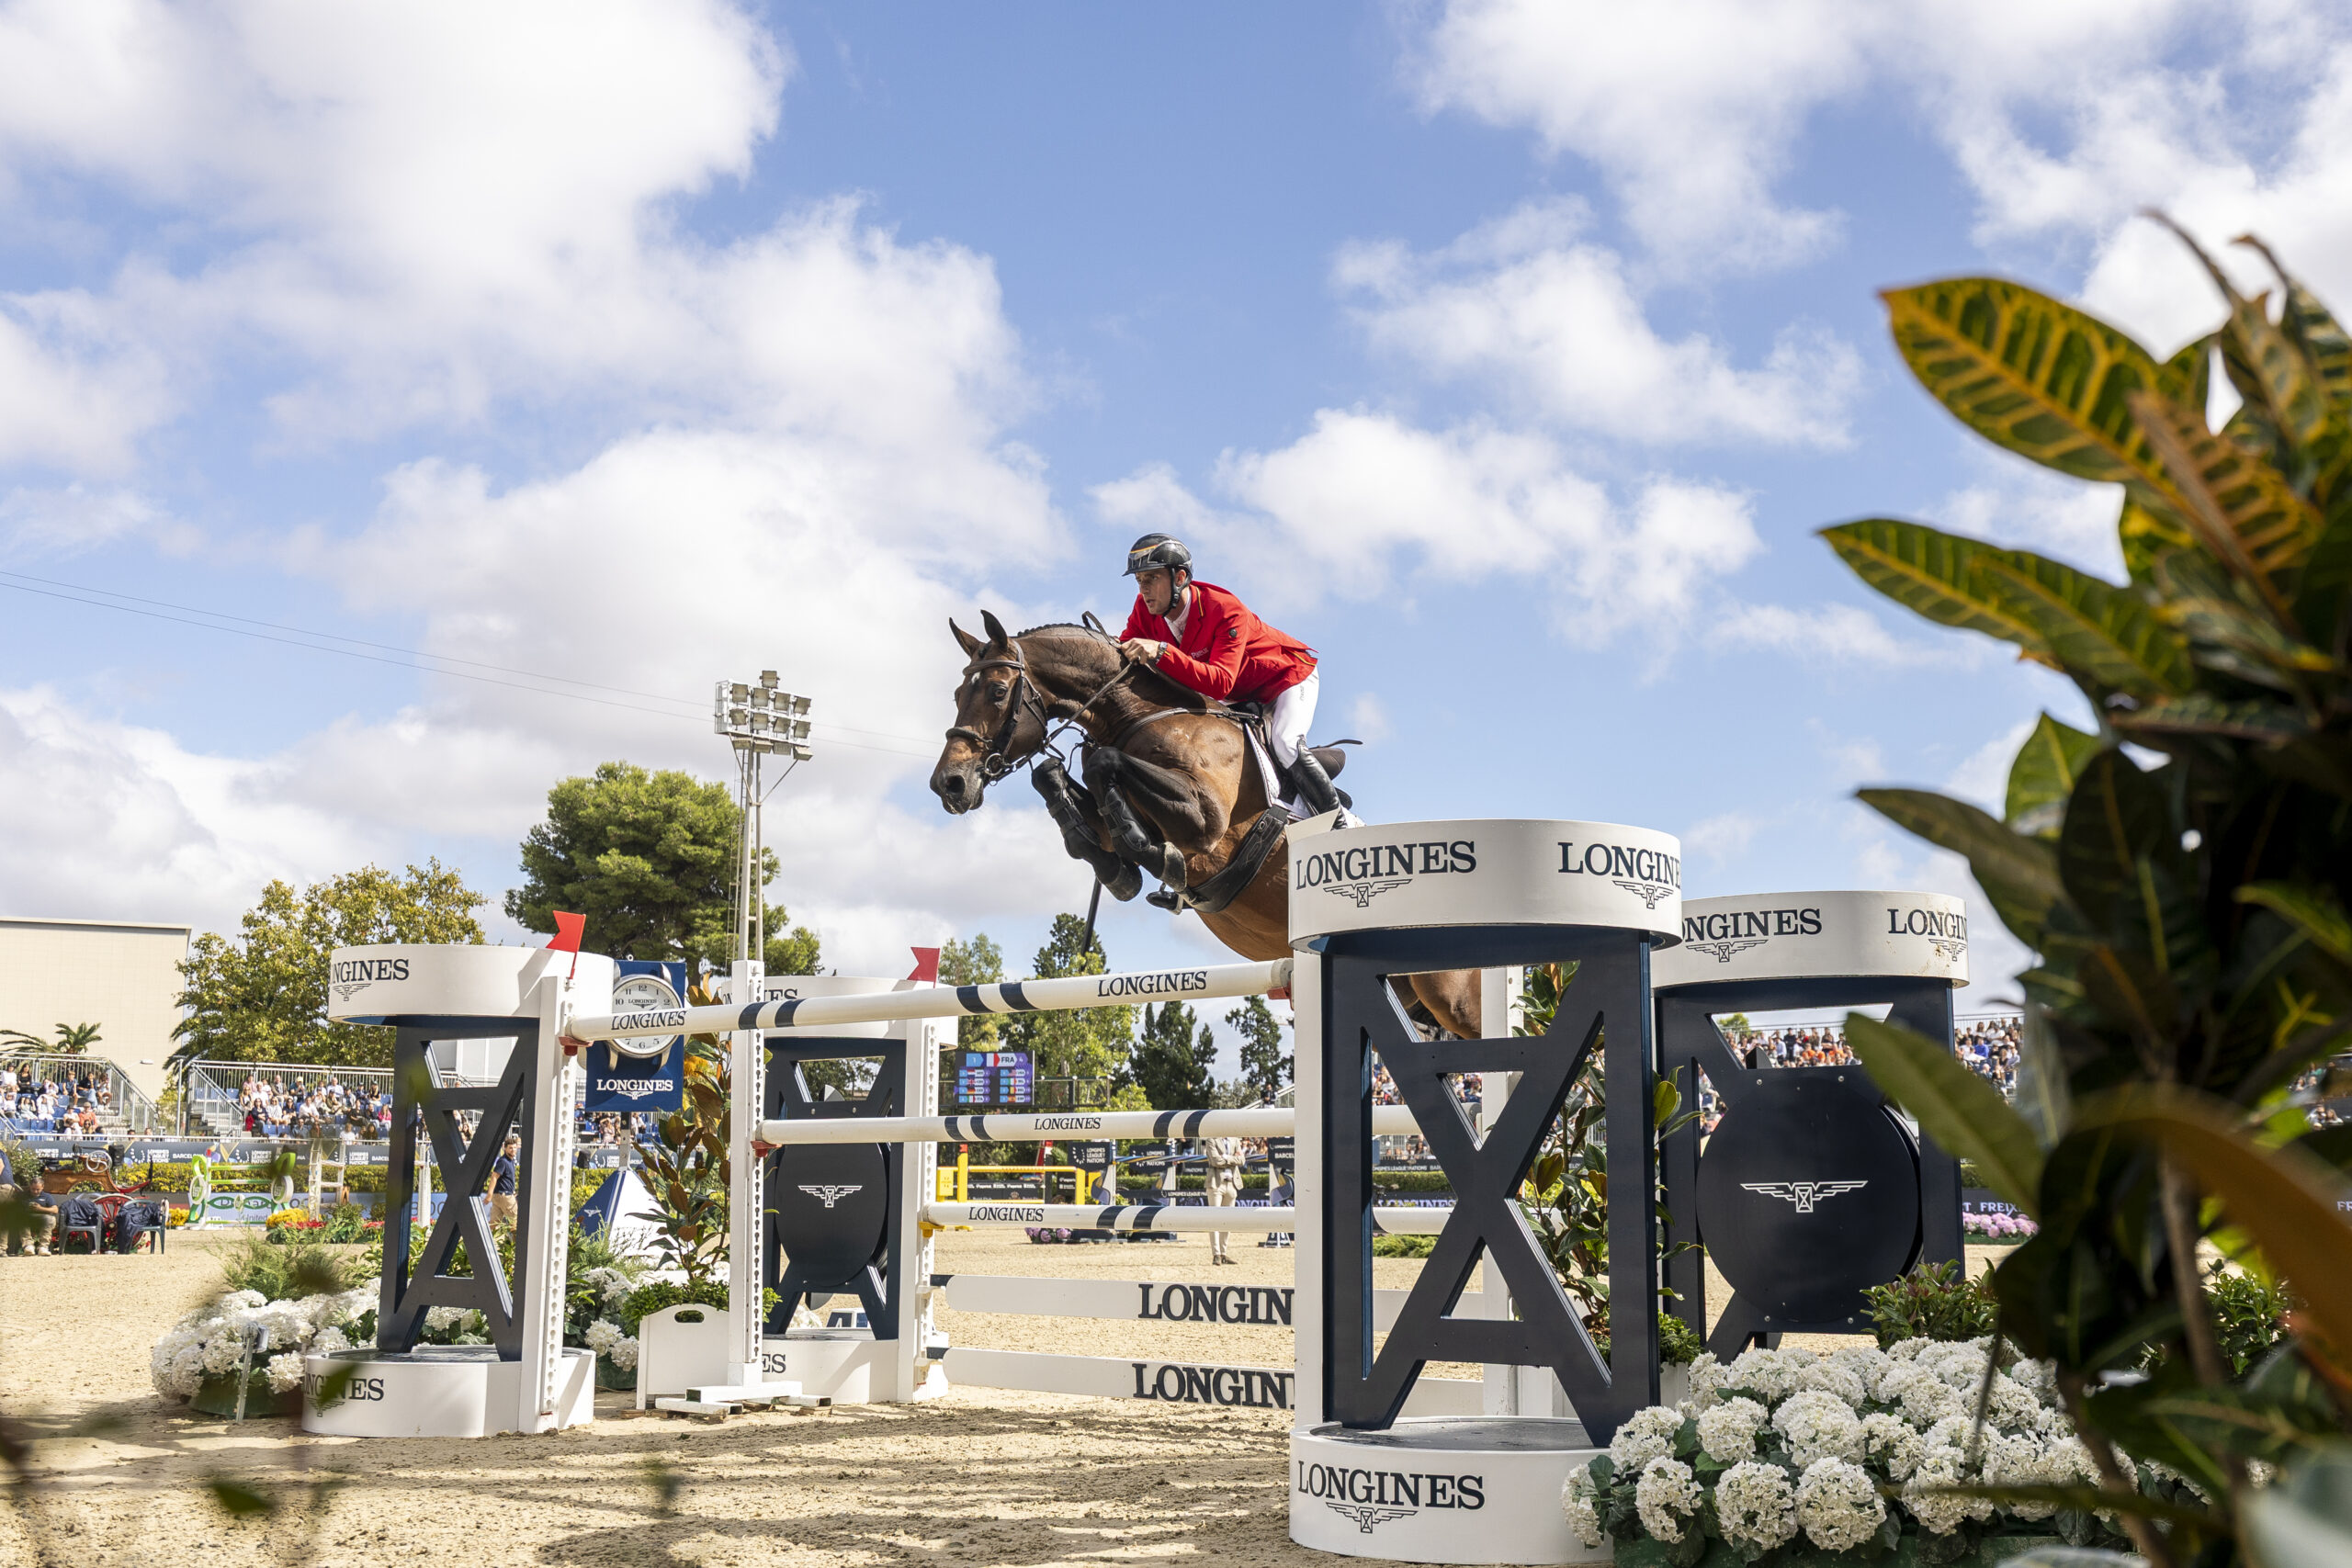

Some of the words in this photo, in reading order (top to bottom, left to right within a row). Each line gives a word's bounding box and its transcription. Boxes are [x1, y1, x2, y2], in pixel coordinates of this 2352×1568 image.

[1295, 840, 1477, 890] LONGINES
[1682, 908, 1822, 942] NGINES
[1098, 971, 1208, 998] LONGINES
[611, 1010, 687, 1031] LONGINES
[596, 1079, 673, 1091] LONGINES
[1035, 1117, 1102, 1130] LONGINES
[968, 1206, 1045, 1222] LONGINES
[1980, 1201, 2021, 1216] FREIX
[1138, 1283, 1295, 1325] LONGIN
[1132, 1363, 1295, 1410] LONGIN
[1297, 1460, 1485, 1510] LONGINES
